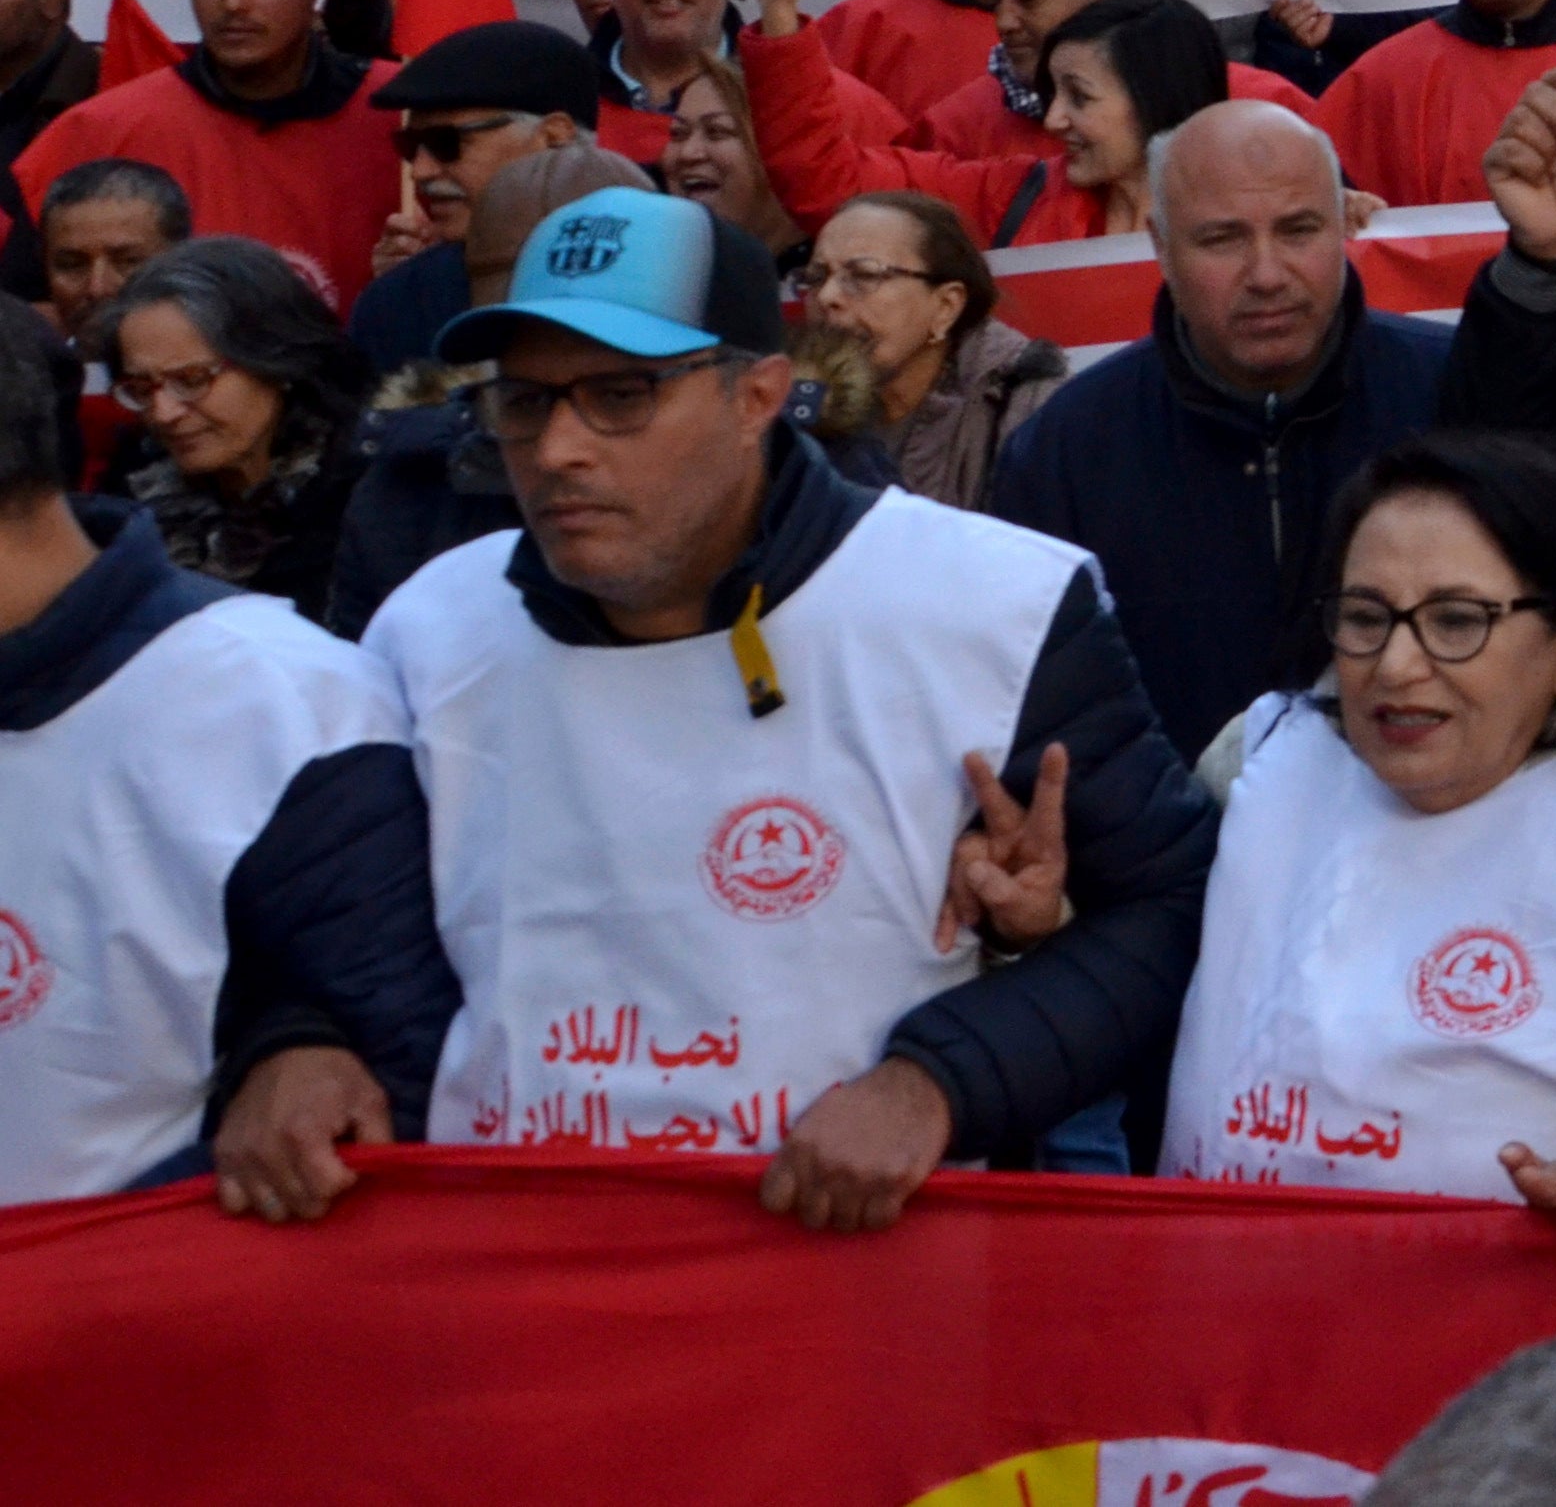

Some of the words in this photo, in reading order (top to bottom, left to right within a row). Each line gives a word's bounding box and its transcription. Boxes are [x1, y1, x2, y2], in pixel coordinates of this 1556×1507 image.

[541, 1004, 640, 1083] البلاد
[648, 1014, 741, 1086] نحب
[1226, 1082, 1308, 1159] البلاد
[1314, 1109, 1402, 1172] نحب
